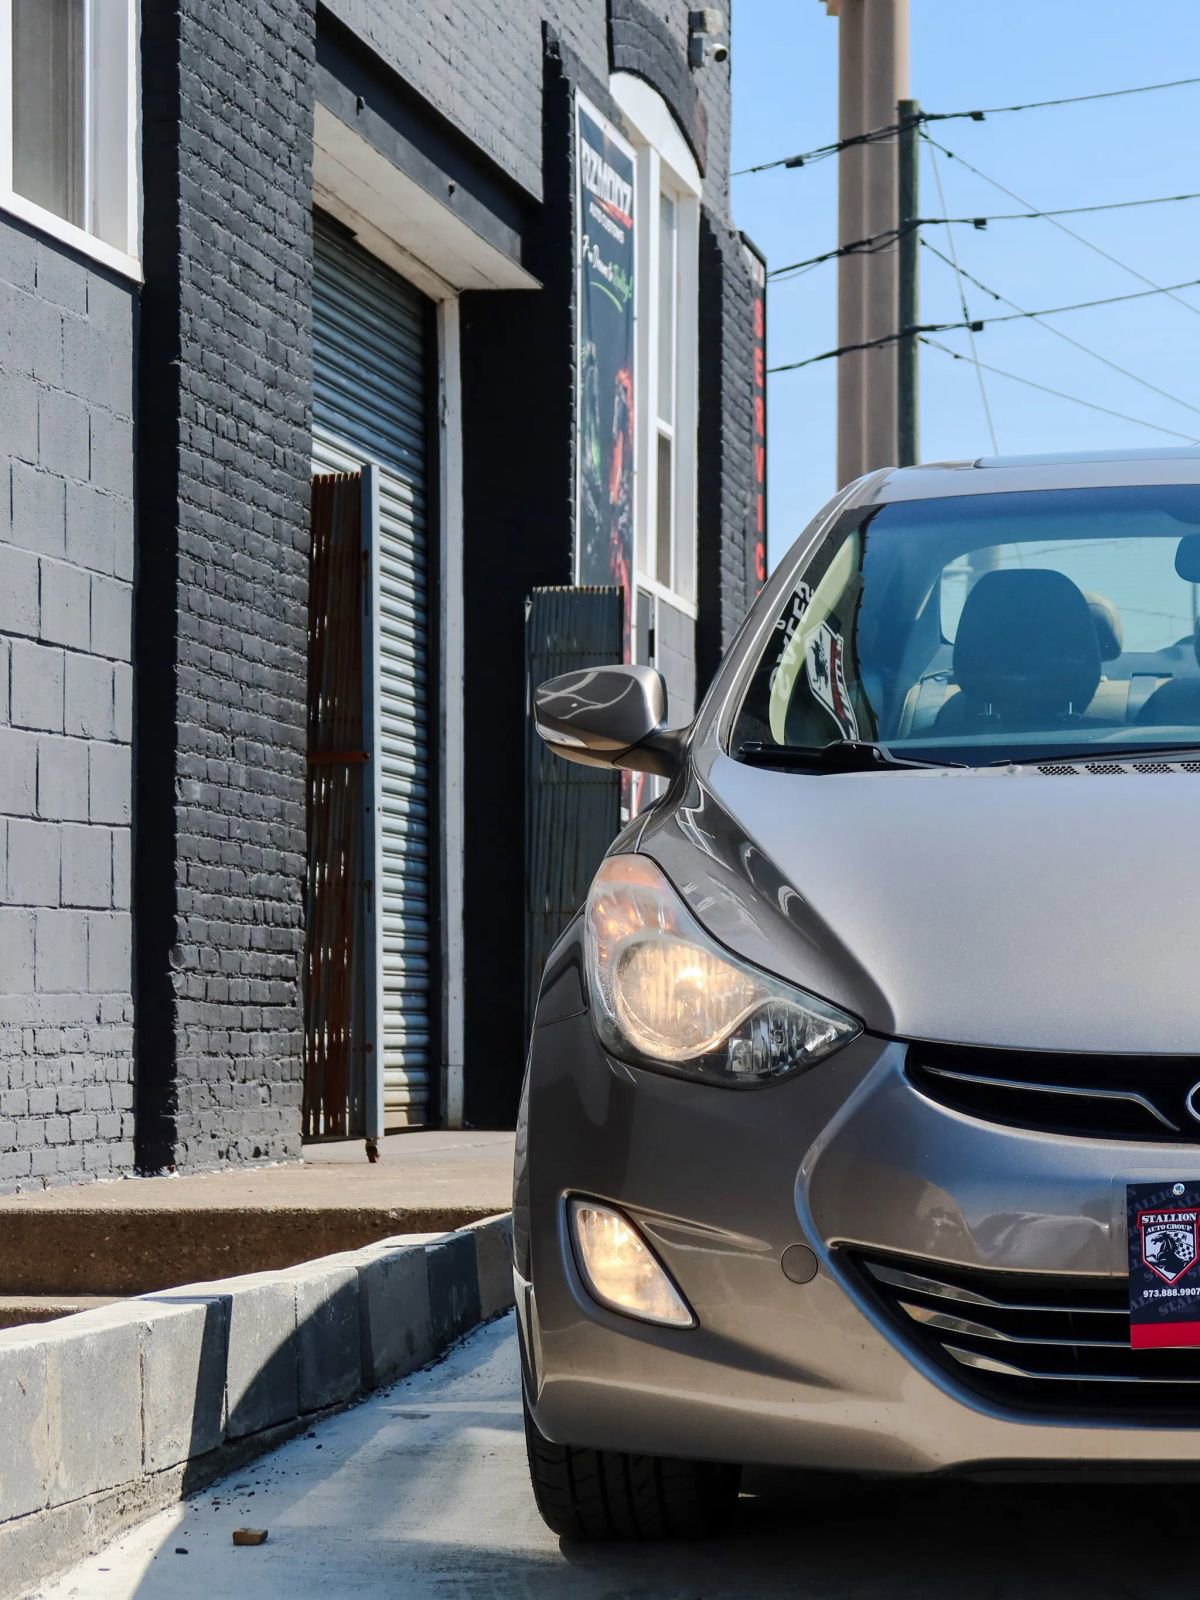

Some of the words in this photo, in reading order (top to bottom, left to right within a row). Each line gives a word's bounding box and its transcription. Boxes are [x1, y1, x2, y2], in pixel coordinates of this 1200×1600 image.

[753, 297, 765, 597] SERVIC
[1141, 1212, 1198, 1224] STALLION
[1146, 1224, 1166, 1234] AUTO
[1166, 1223, 1193, 1231] GROUP
